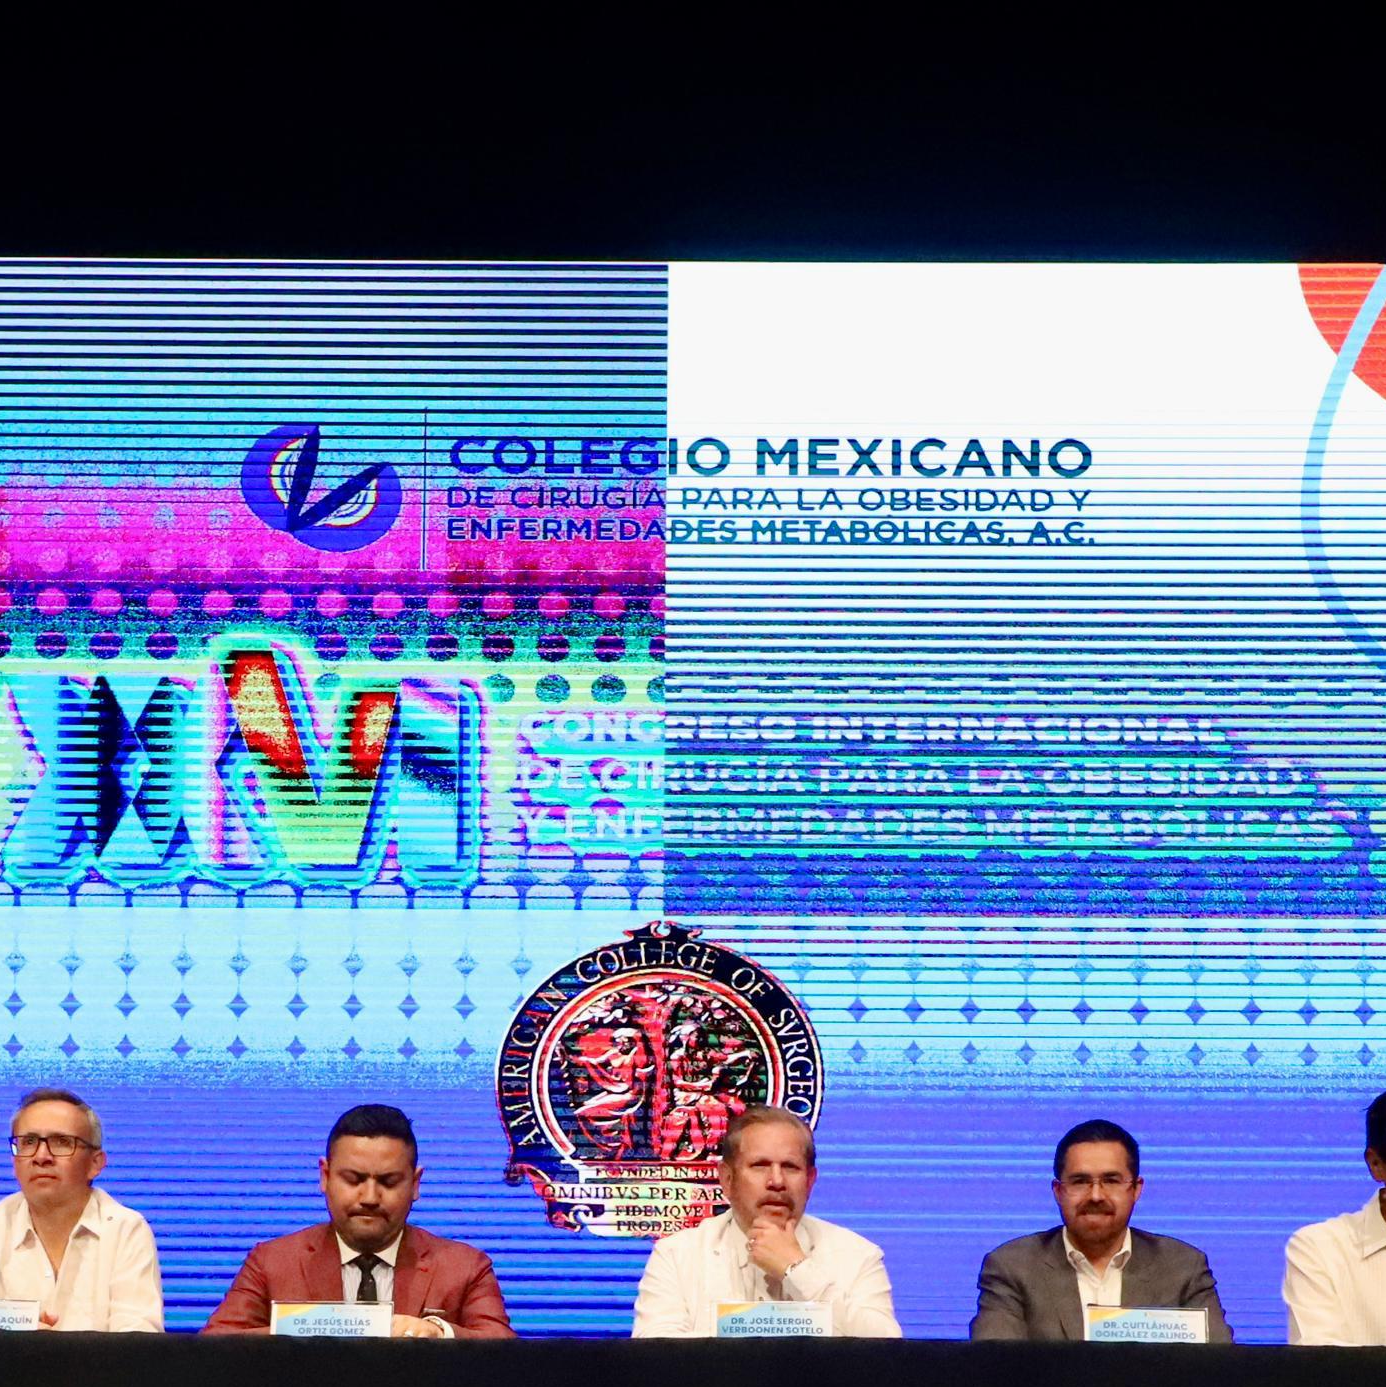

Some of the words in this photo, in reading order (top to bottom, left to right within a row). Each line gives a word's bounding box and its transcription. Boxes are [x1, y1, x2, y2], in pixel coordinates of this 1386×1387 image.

[450, 435, 731, 477] COLEGIO
[756, 437, 1093, 478] MEXICANO
[447, 486, 494, 509] DE
[681, 487, 782, 511] PARA
[796, 487, 844, 512] LA
[857, 487, 1056, 512] OBESIDAD
[1066, 488, 1094, 512] Y
[447, 517, 739, 543] ENFERMEDADES
[575, 942, 721, 985] COLLEGE
[731, 967, 774, 1000] OF
[769, 1008, 816, 1118] SVRGEO
[649, 1187, 687, 1201] PER
[776, 1317, 814, 1326] SERGIO
[786, 1326, 824, 1335] SOTELO
